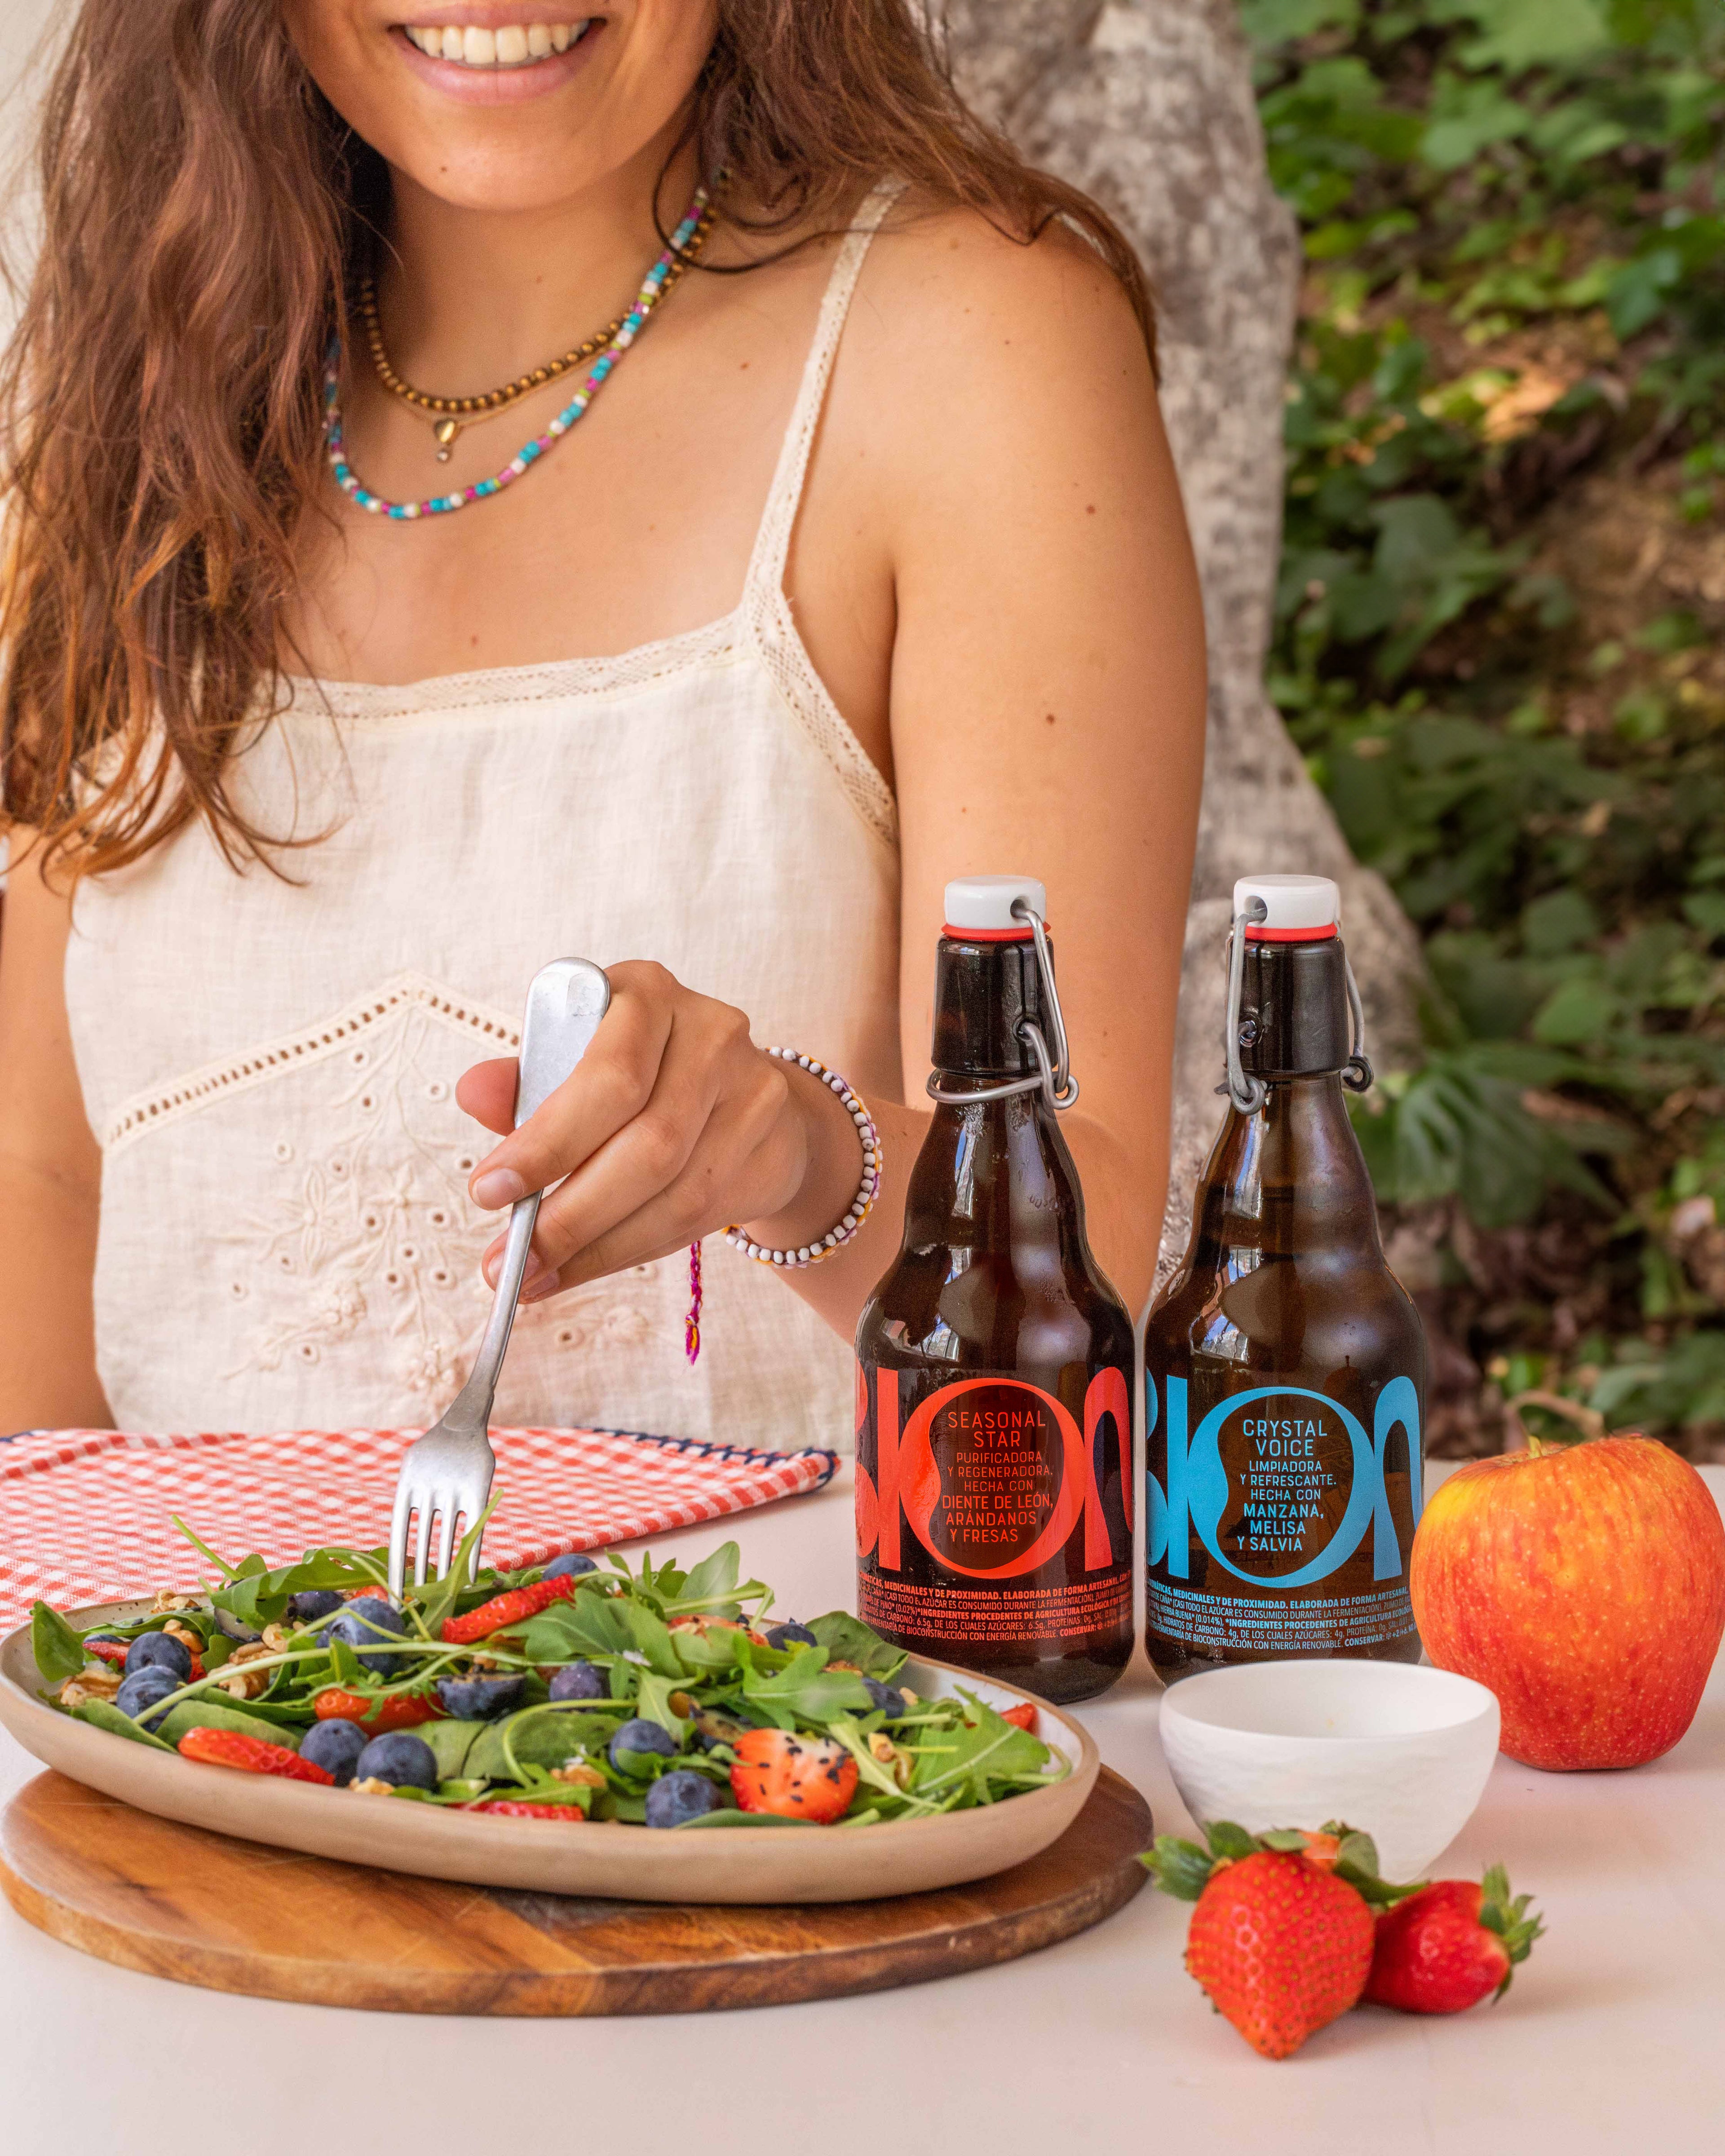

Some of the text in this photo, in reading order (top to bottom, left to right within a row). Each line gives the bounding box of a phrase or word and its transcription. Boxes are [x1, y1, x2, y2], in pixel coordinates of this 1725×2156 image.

[948, 1410, 1045, 1428] SEASONAL
[1243, 1419, 1327, 1437] CRYSTAL
[973, 1431, 1020, 1448] STAR
[1256, 1439, 1314, 1457] VOICE
[957, 1451, 1042, 1463] PURIFICADORA
[947, 1465, 1053, 1478] Y REGENERADORA.
[1249, 1460, 1322, 1472] LIMPIADORA
[964, 1480, 1033, 1492] HECHA CON
[1240, 1474, 1337, 1487] Y REFRESCANTE.
[942, 1491, 1053, 1510] DIENTE DE LEÓN,
[1251, 1489, 1321, 1501] HECHA CON
[946, 1510, 1036, 1526] ARÁNDANOS
[1244, 1503, 1324, 1519] MANZANA,
[1250, 1520, 1306, 1535] MELISA
[950, 1529, 1018, 1543] Y FRESAS
[1237, 1536, 1303, 1551] Y SALVIA
[884, 1581, 928, 1596] MEDICINALES
[929, 1588, 933, 1597] Y
[935, 1589, 945, 1598] DE
[946, 1590, 1001, 1600] PROXIMIDAD.
[1003, 1589, 1051, 1599] ELABORADA
[1053, 1588, 1062, 1597] DE
[1064, 1584, 1088, 1595] FORMA
[1173, 1588, 1215, 1604] MEDICINALES
[1216, 1596, 1221, 1605] Y
[1222, 1597, 1232, 1607] DE
[1233, 1598, 1288, 1609] PROXIMIDAD.
[1290, 1599, 1339, 1609] ELABORADA
[1340, 1598, 1350, 1606] DE
[1351, 1595, 1376, 1605] FORMA
[898, 1594, 914, 1604] TODO
[915, 1597, 921, 1605] EL
[949, 1600, 957, 1609] ES
[958, 1601, 1002, 1610] CONSUMIDO
[1004, 1601, 1036, 1610] DURANTE
[1038, 1600, 1045, 1608] LA
[1173, 1599, 1185, 1609] (CASI
[1185, 1602, 1200, 1613] TODO
[1202, 1605, 1208, 1614] EL
[1209, 1605, 1233, 1617] AZÚCAR
[1234, 1608, 1243, 1617] ES
[1244, 1609, 1288, 1619] CONSUMIDO
[1290, 1610, 1322, 1619] DURANTE
[1324, 1609, 1332, 1618] LA
[879, 1610, 885, 1618] DE
[935, 1620, 943, 1628] DE
[946, 1621, 958, 1629] LOS
[960, 1622, 986, 1630] CUALES
[971, 1612, 1022, 1621] PROCEDENTES
[1024, 1612, 1034, 1620] DE
[1035, 1606, 1079, 1619] AGRICULTURA
[1284, 1619, 1337, 1630] PROCEDENTES
[1339, 1618, 1348, 1627] DE
[1349, 1611, 1392, 1626] AGRICULTURA
[898, 1625, 906, 1634] DE
[907, 1626, 968, 1640] BIOCONSTRUCCIÓN
[969, 1632, 985, 1640] CON
[986, 1630, 1017, 1641] ENERGÍA
[1163, 1616, 1185, 1629] HIDRATOS
[1186, 1622, 1193, 1631] DE
[1195, 1624, 1226, 1636] CARBONO:
[1228, 1628, 1238, 1639] 4g,
[1240, 1630, 1250, 1638] DE
[1252, 1630, 1265, 1639] LOS
[1267, 1631, 1293, 1639] CUALES
[1295, 1629, 1332, 1639] AZÚCARES:
[1185, 1632, 1192, 1641] DE
[1193, 1634, 1252, 1649] BIOCONSTRUCCIÓN
[1254, 1641, 1269, 1649] CON
[1271, 1640, 1301, 1650] ENERGÍA
[1302, 1639, 1343, 1650] RENOVABLE.
[1345, 1633, 1385, 1647] CONSERVAR:
